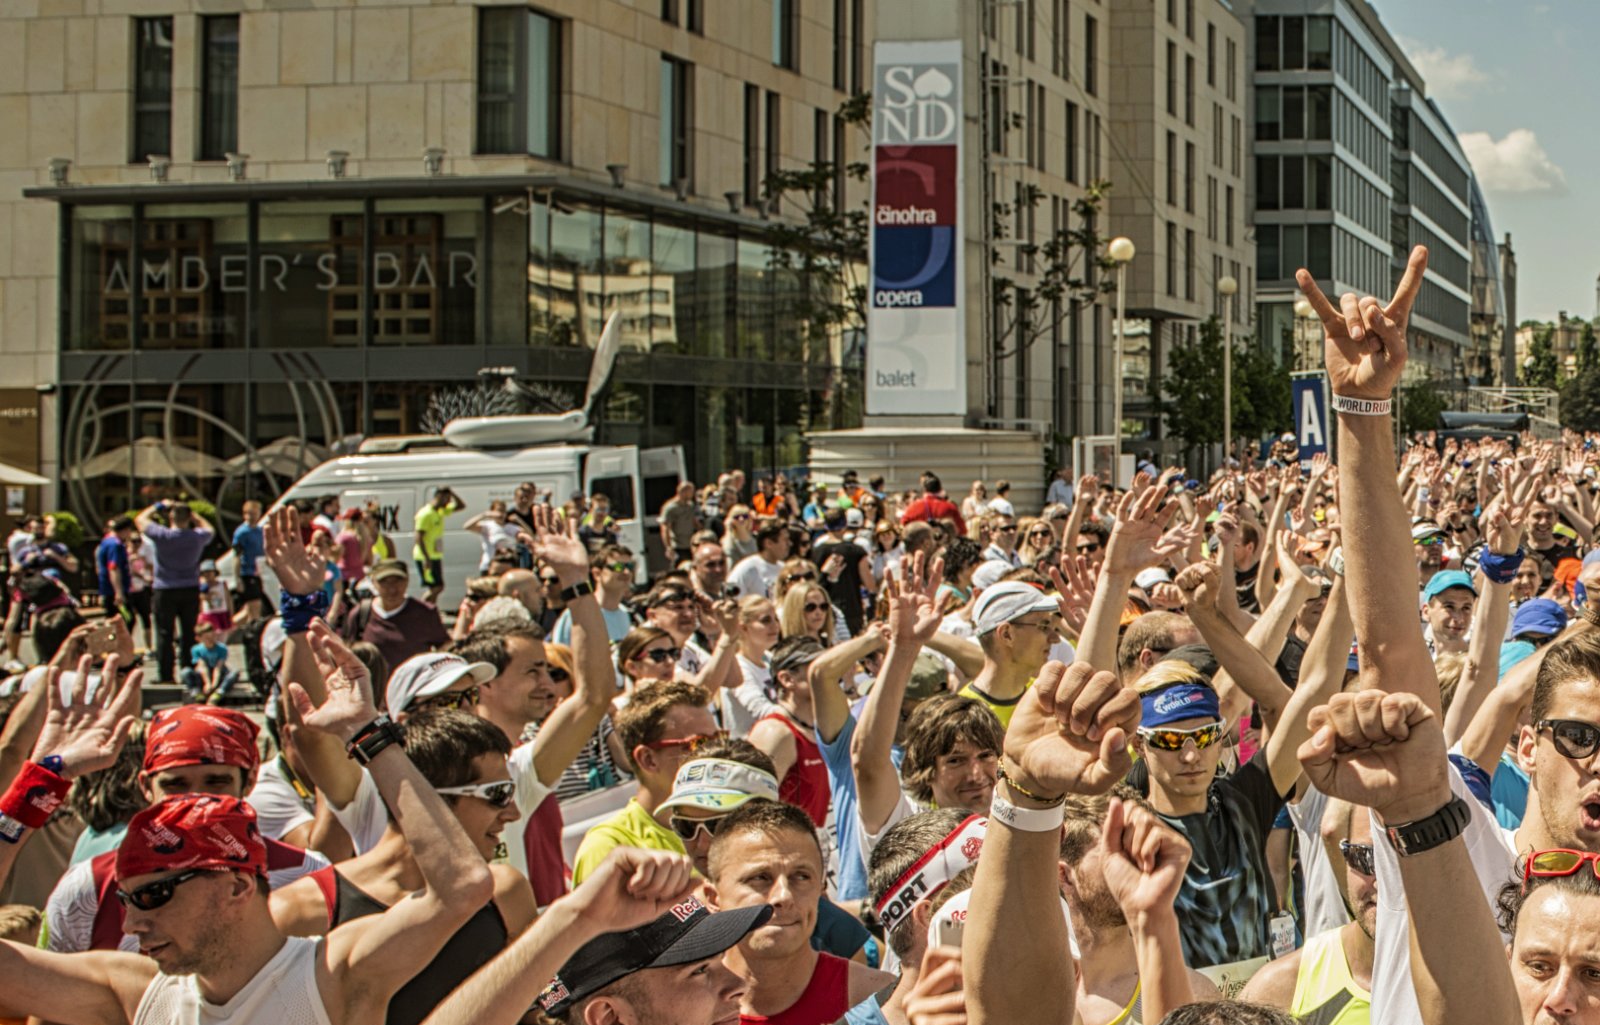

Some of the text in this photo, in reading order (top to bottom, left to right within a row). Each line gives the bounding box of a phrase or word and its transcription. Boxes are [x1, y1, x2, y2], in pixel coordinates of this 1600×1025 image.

[876, 204, 936, 225] činohra
[104, 251, 479, 293] AMBER'S BAR
[876, 289, 923, 308] opera
[876, 370, 916, 387] balet
[1301, 389, 1324, 446] A
